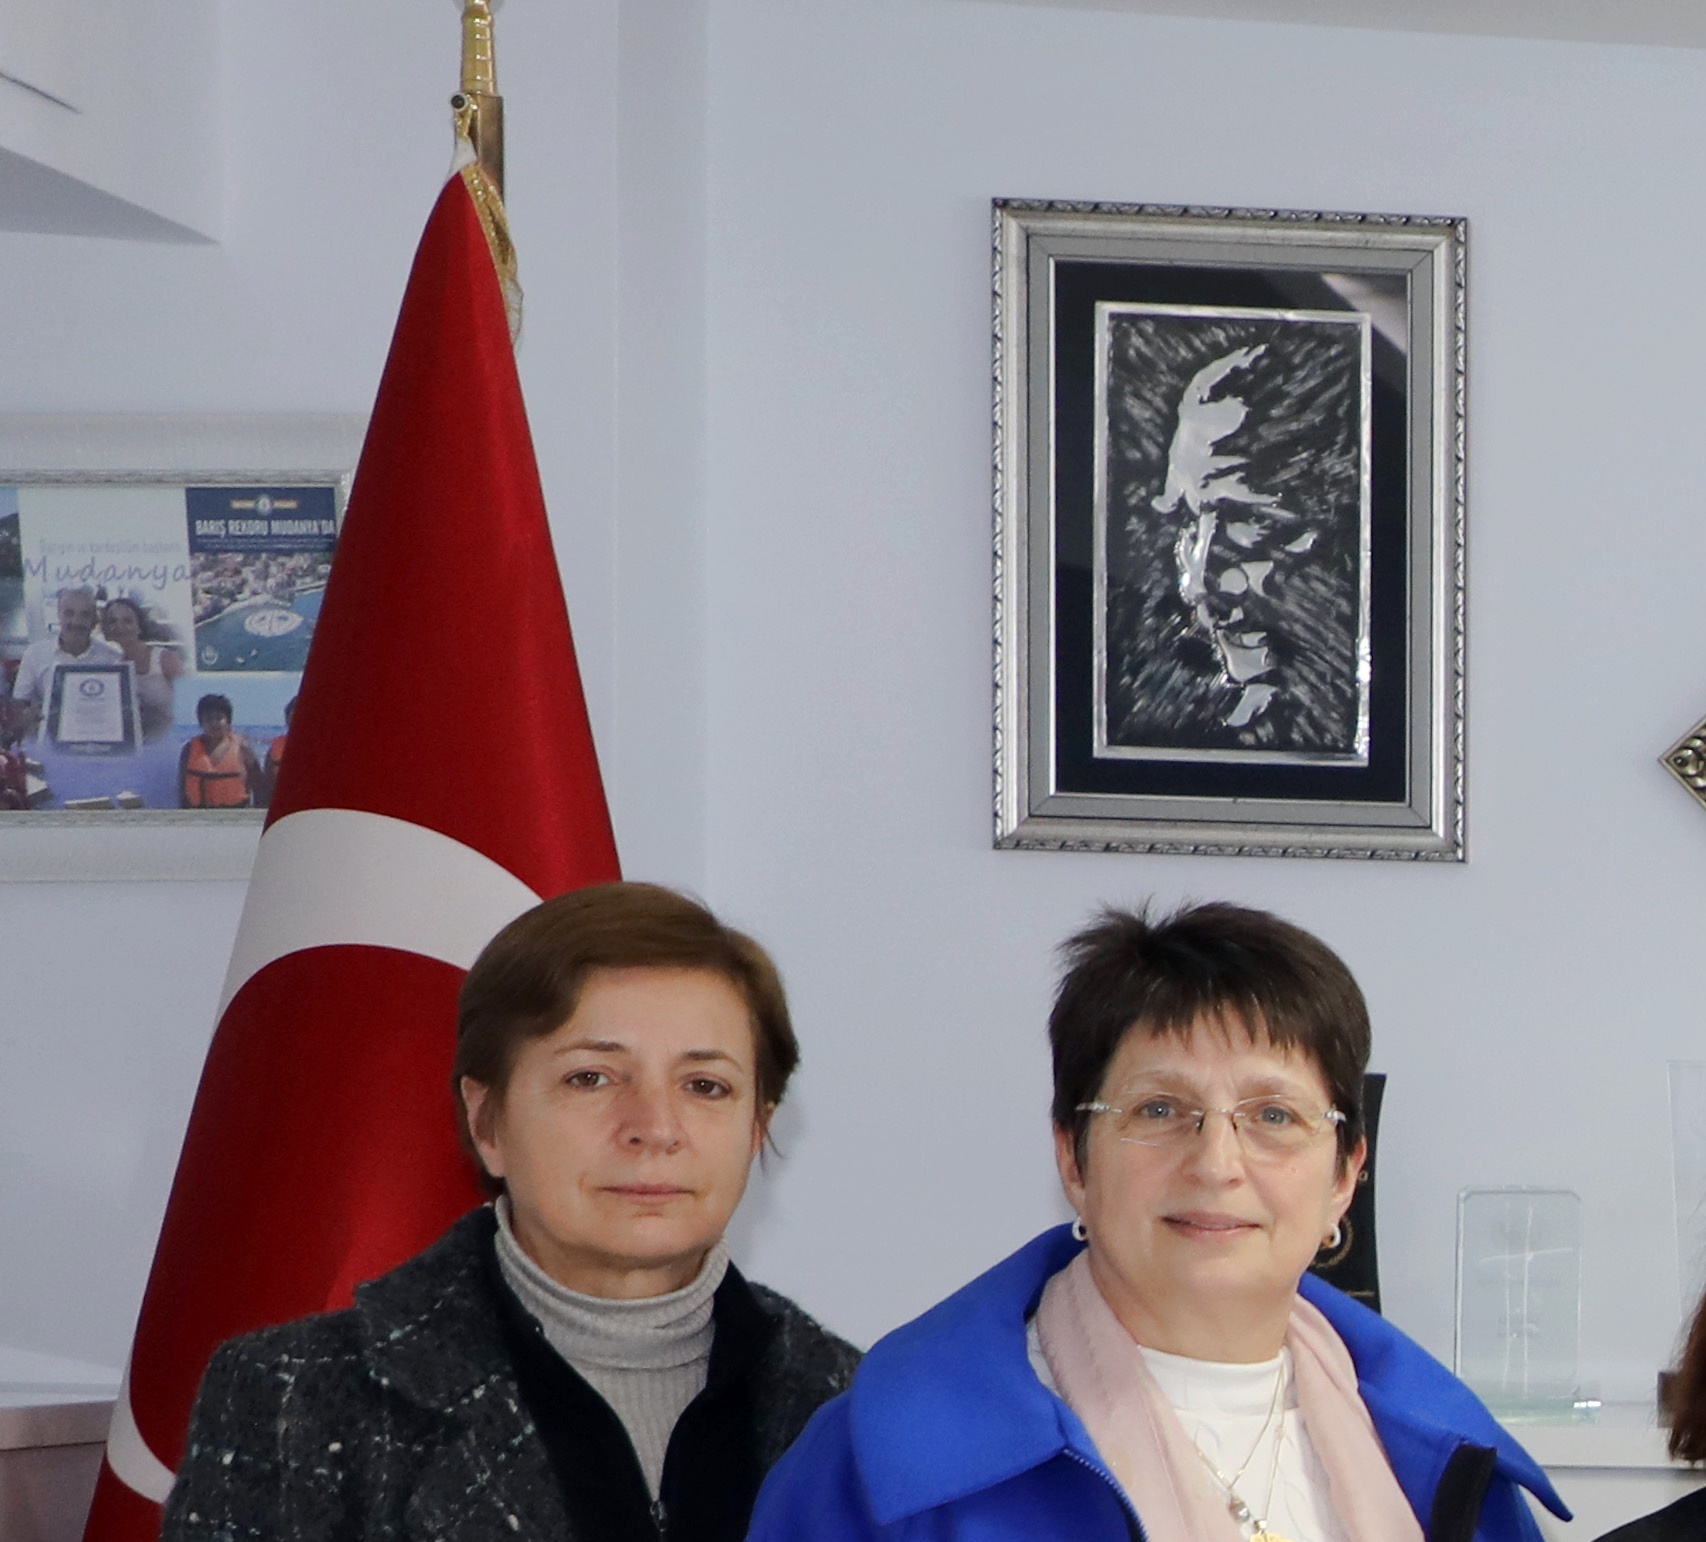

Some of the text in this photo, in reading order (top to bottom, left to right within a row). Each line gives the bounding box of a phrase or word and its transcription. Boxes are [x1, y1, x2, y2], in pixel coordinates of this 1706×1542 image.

[195, 519, 226, 538] BARIŞ
[228, 519, 268, 536] REKORU
[22, 555, 195, 590] Mudanya
